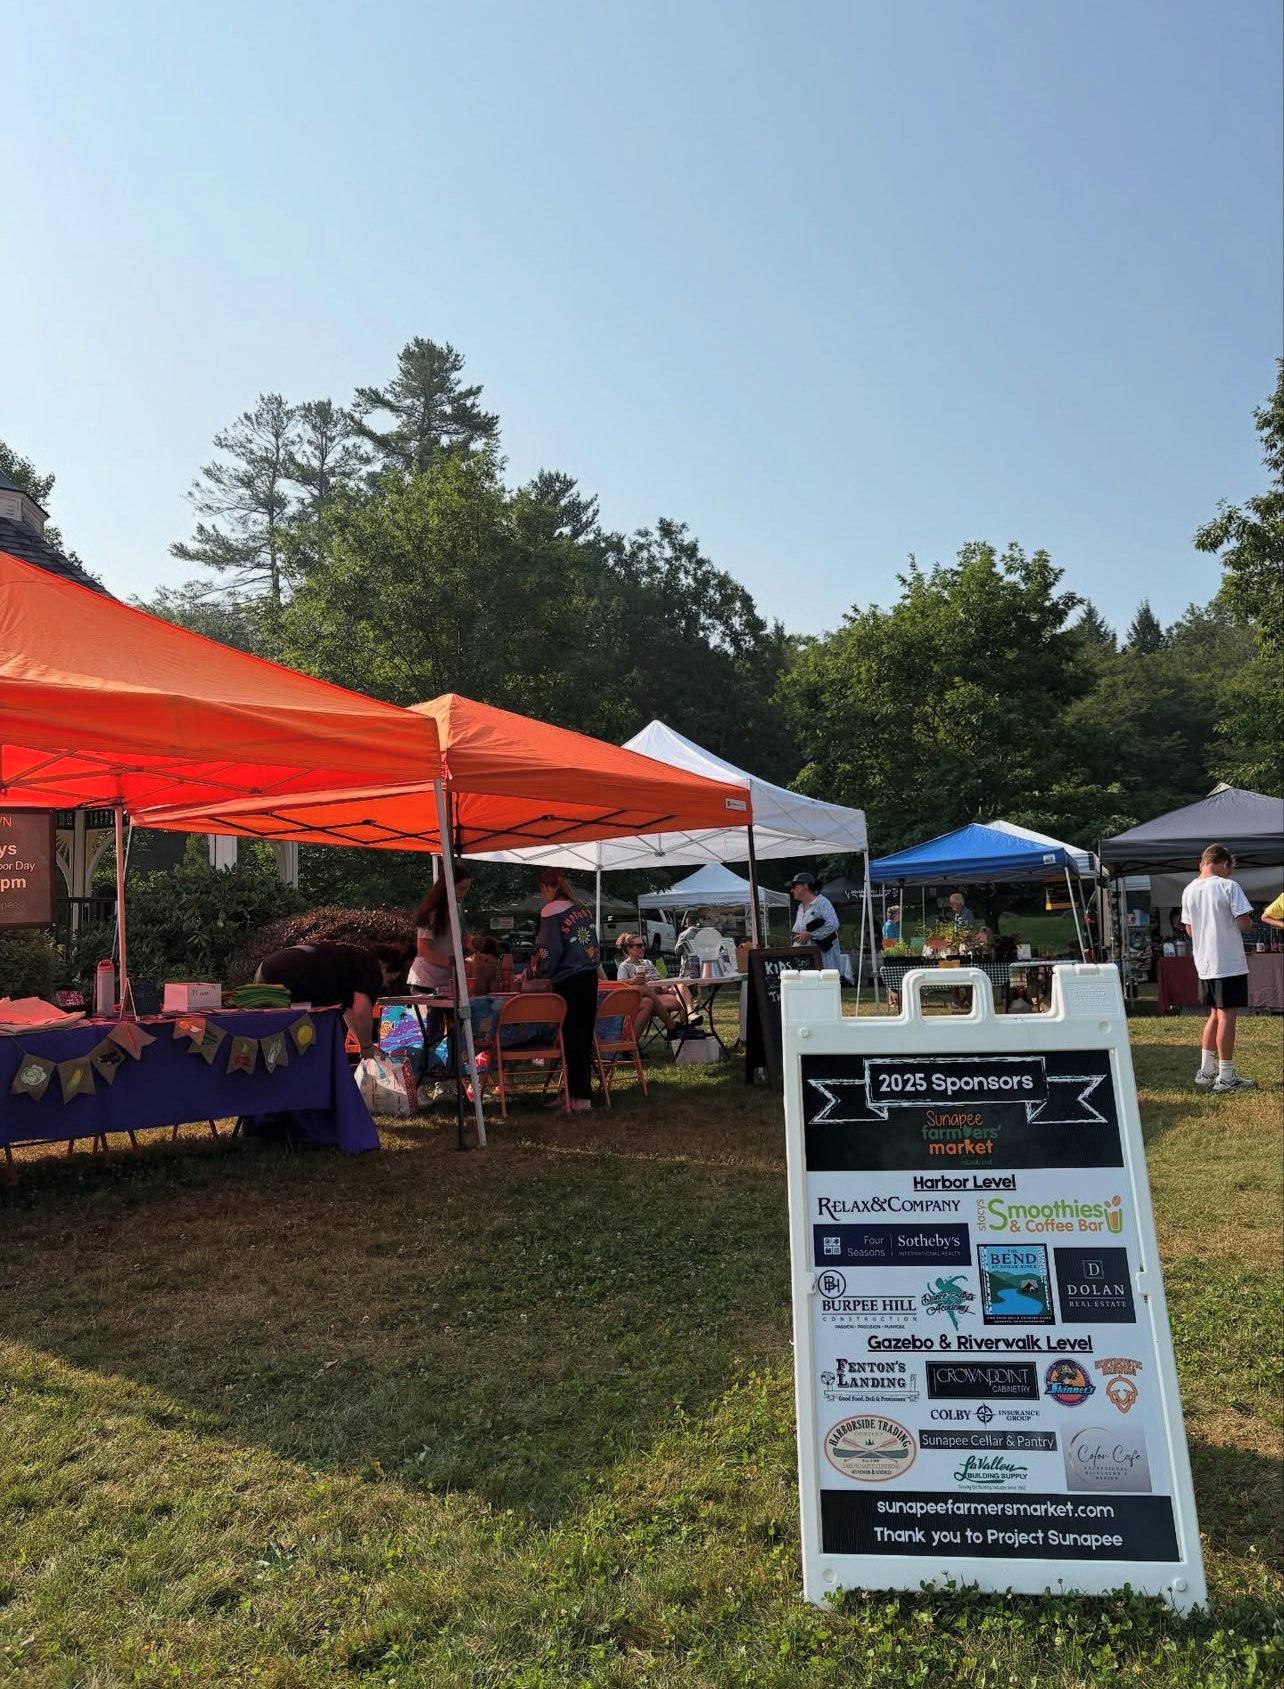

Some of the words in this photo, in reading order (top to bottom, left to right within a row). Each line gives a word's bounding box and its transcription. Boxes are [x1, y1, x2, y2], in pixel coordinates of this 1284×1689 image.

[15, 861, 36, 871] Day
[878, 1073, 928, 1092] 2025
[931, 1073, 1034, 1095] Sponsors
[926, 1110, 984, 1128] Sunapee
[929, 1136, 994, 1155] market
[913, 1175, 969, 1190] Harbor
[973, 1174, 1016, 1190] Level
[987, 1198, 1104, 1231] Smoothies
[1009, 1220, 1021, 1233] &
[1025, 1219, 1074, 1233] Coffee
[1079, 1219, 1104, 1232] Bar
[863, 1235, 884, 1245] Four
[897, 1233, 961, 1249] Sotheby's
[847, 1248, 886, 1257] Seasons
[990, 1253, 1037, 1264] BEND
[1067, 1284, 1126, 1296] DOLAN
[822, 1300, 878, 1312] BURPEE
[882, 1299, 917, 1312] HILL
[867, 1335, 934, 1350] Gazebo
[939, 1334, 952, 1350] &
[957, 1334, 1042, 1350] Riverwalk
[1047, 1335, 1093, 1351] Level
[835, 1358, 906, 1373] FENTON'S
[836, 1373, 906, 1388] LANDING
[991, 1385, 1031, 1393] CABINETRY
[930, 1409, 971, 1420] COLBY
[828, 1419, 876, 1447] HARBORSIDE
[878, 1420, 912, 1448] TRADING
[922, 1434, 968, 1447] Sunapee
[970, 1434, 1003, 1447] Cellar
[1005, 1435, 1015, 1447] &
[1017, 1436, 1054, 1449] Pantry
[877, 1500, 1115, 1518] sunapeefarmersmarket.com
[873, 1527, 926, 1543] Thank
[932, 1531, 960, 1547] you
[965, 1528, 983, 1544] to
[987, 1529, 1045, 1548] Project
[1048, 1530, 1124, 1550] Sunapee
